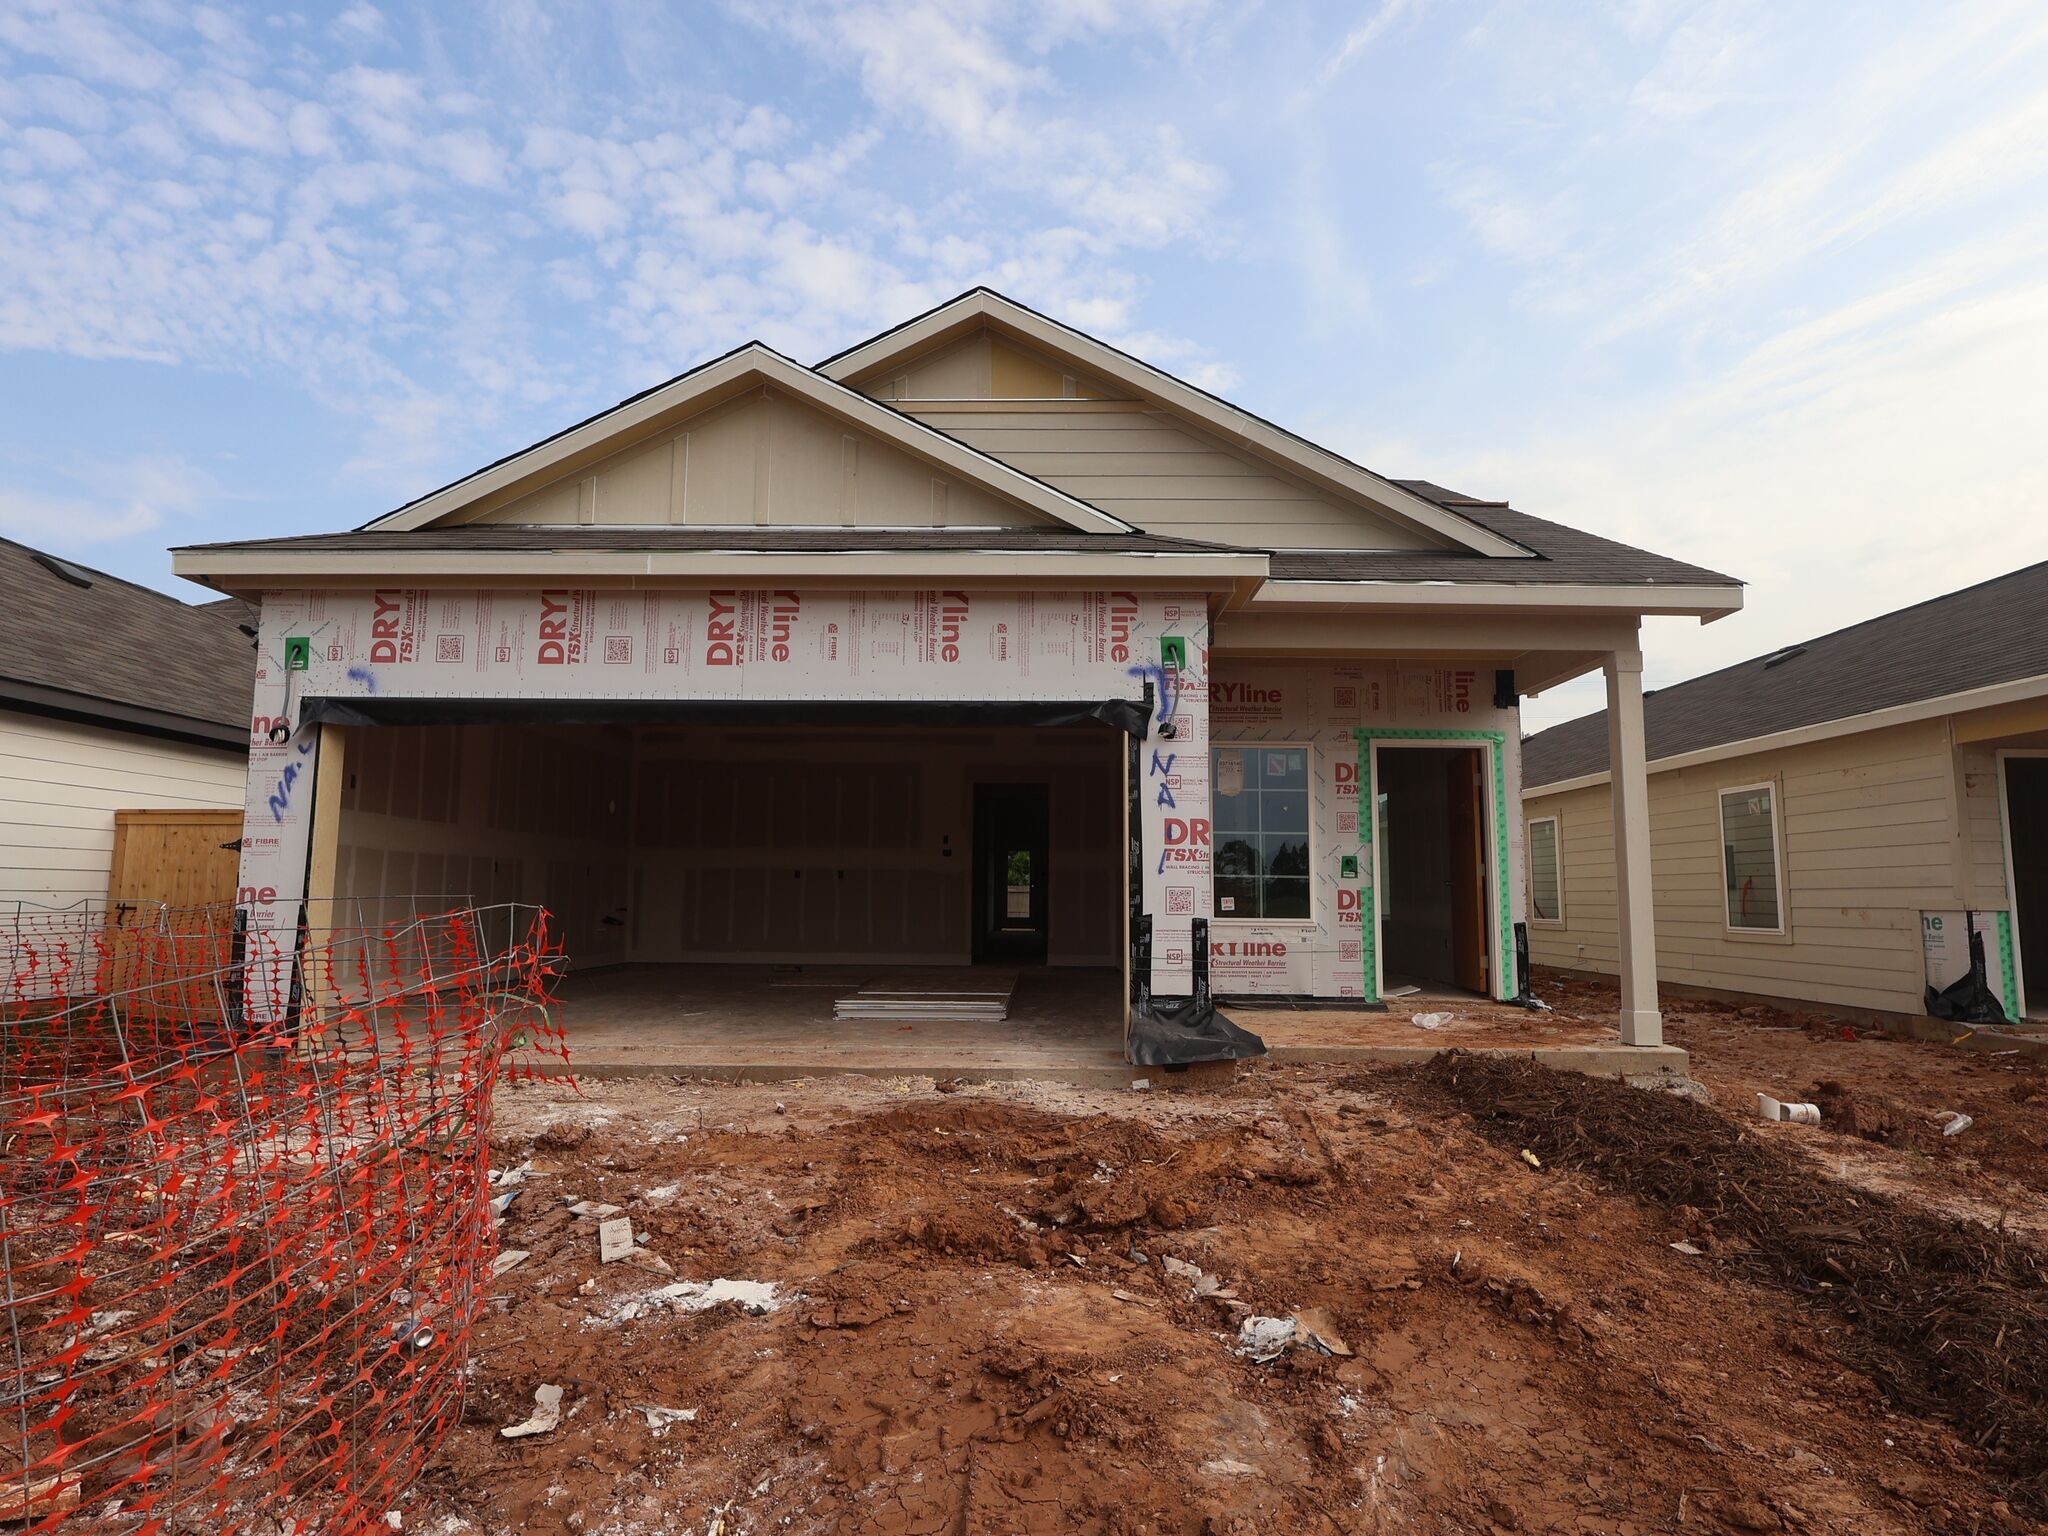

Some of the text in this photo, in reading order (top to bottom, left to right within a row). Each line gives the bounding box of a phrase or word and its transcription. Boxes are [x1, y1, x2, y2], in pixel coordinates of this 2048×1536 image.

[399, 596, 414, 663] TSX Structural
[567, 597, 581, 664] TSX Structural
[759, 606, 768, 635] Weather
[929, 606, 938, 635] Weather
[1098, 606, 1107, 635] Weather
[759, 637, 768, 662] Barrier
[929, 638, 938, 662] Barrier
[1098, 638, 1107, 662] Barrier
[1455, 671, 1475, 713] line
[1166, 778, 1180, 786] NSP
[1164, 818, 1209, 845] DR
[1165, 848, 1200, 862] TSX
[1215, 959, 1286, 967] Structural Weather Barrier
